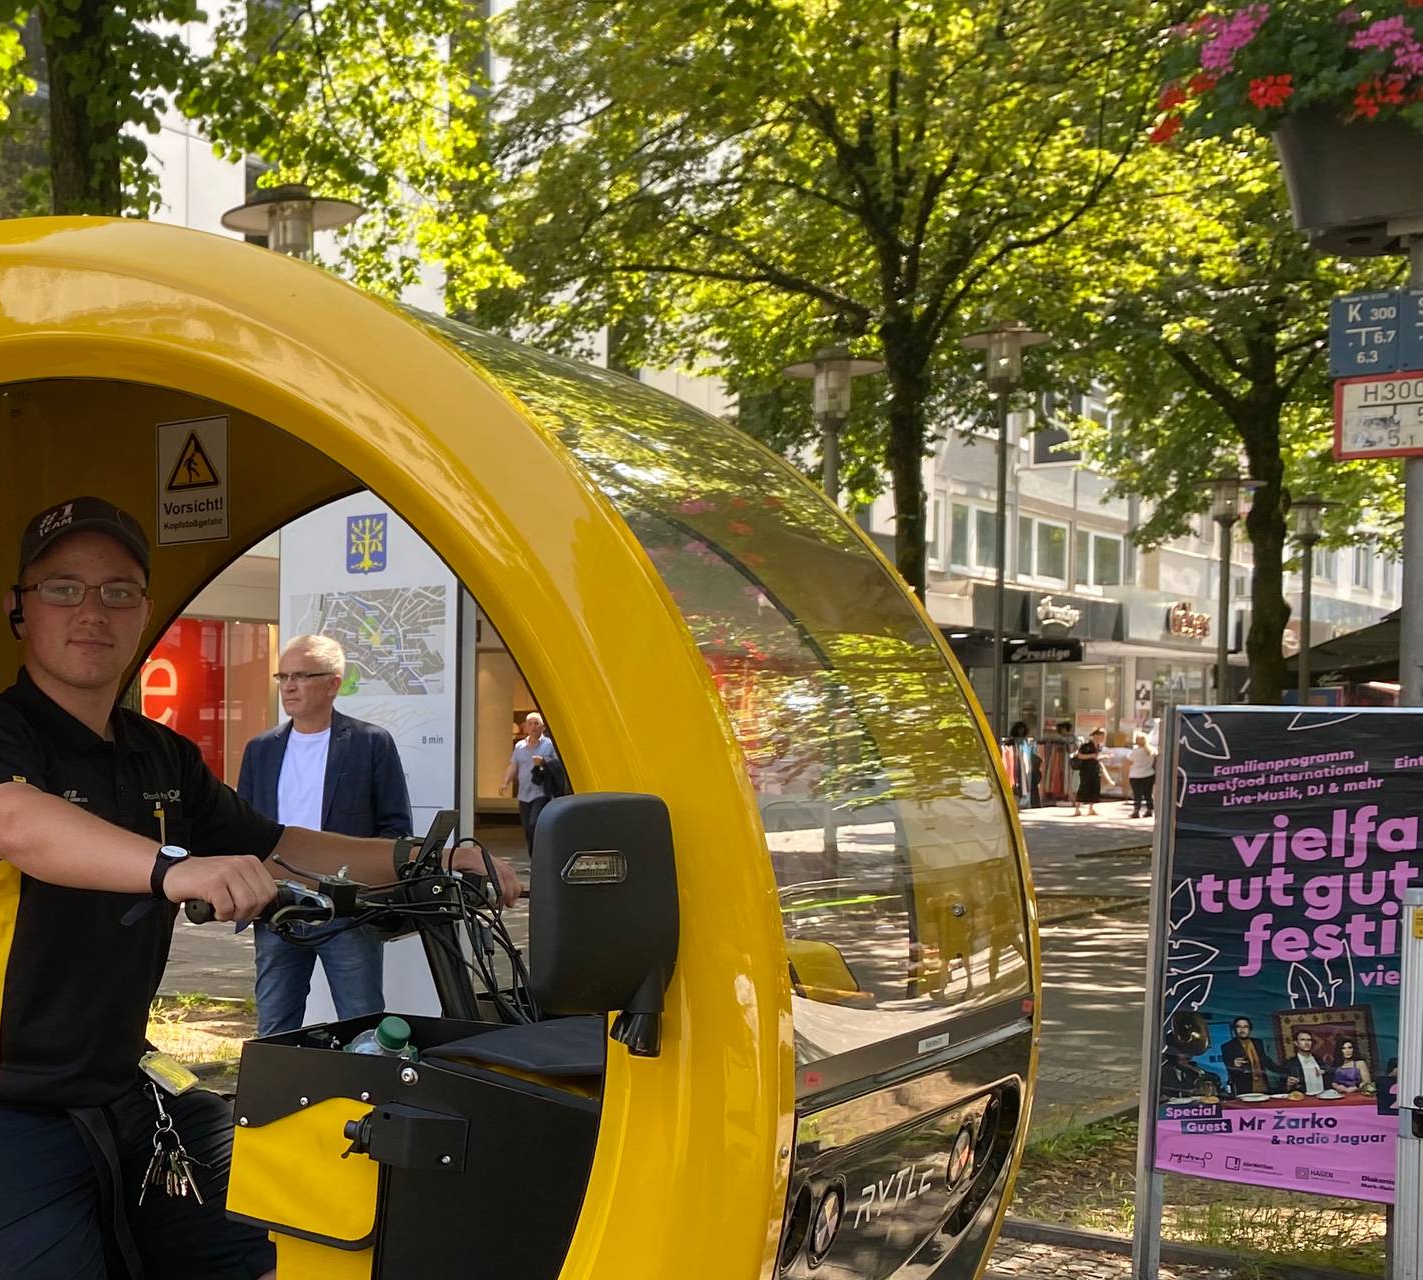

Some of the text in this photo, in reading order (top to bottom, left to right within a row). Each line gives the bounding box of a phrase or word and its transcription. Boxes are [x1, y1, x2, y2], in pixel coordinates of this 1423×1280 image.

[1348, 303, 1397, 322] K 300
[1357, 350, 1378, 364] 6.3
[163, 497, 223, 515] Vorsicht!
[1213, 750, 1355, 777] Familienprogramm
[1188, 762, 1369, 795] Streetfood International
[1222, 776, 1385, 806] Live-Musik, DJ & mehr
[1196, 860, 1419, 921] tut gut
[1165, 1103, 1216, 1119] Special
[1238, 1110, 1338, 1131] Mr Žarko
[1186, 1120, 1228, 1133] Guest
[1270, 1133, 1387, 1146] & Radio Jaguar
